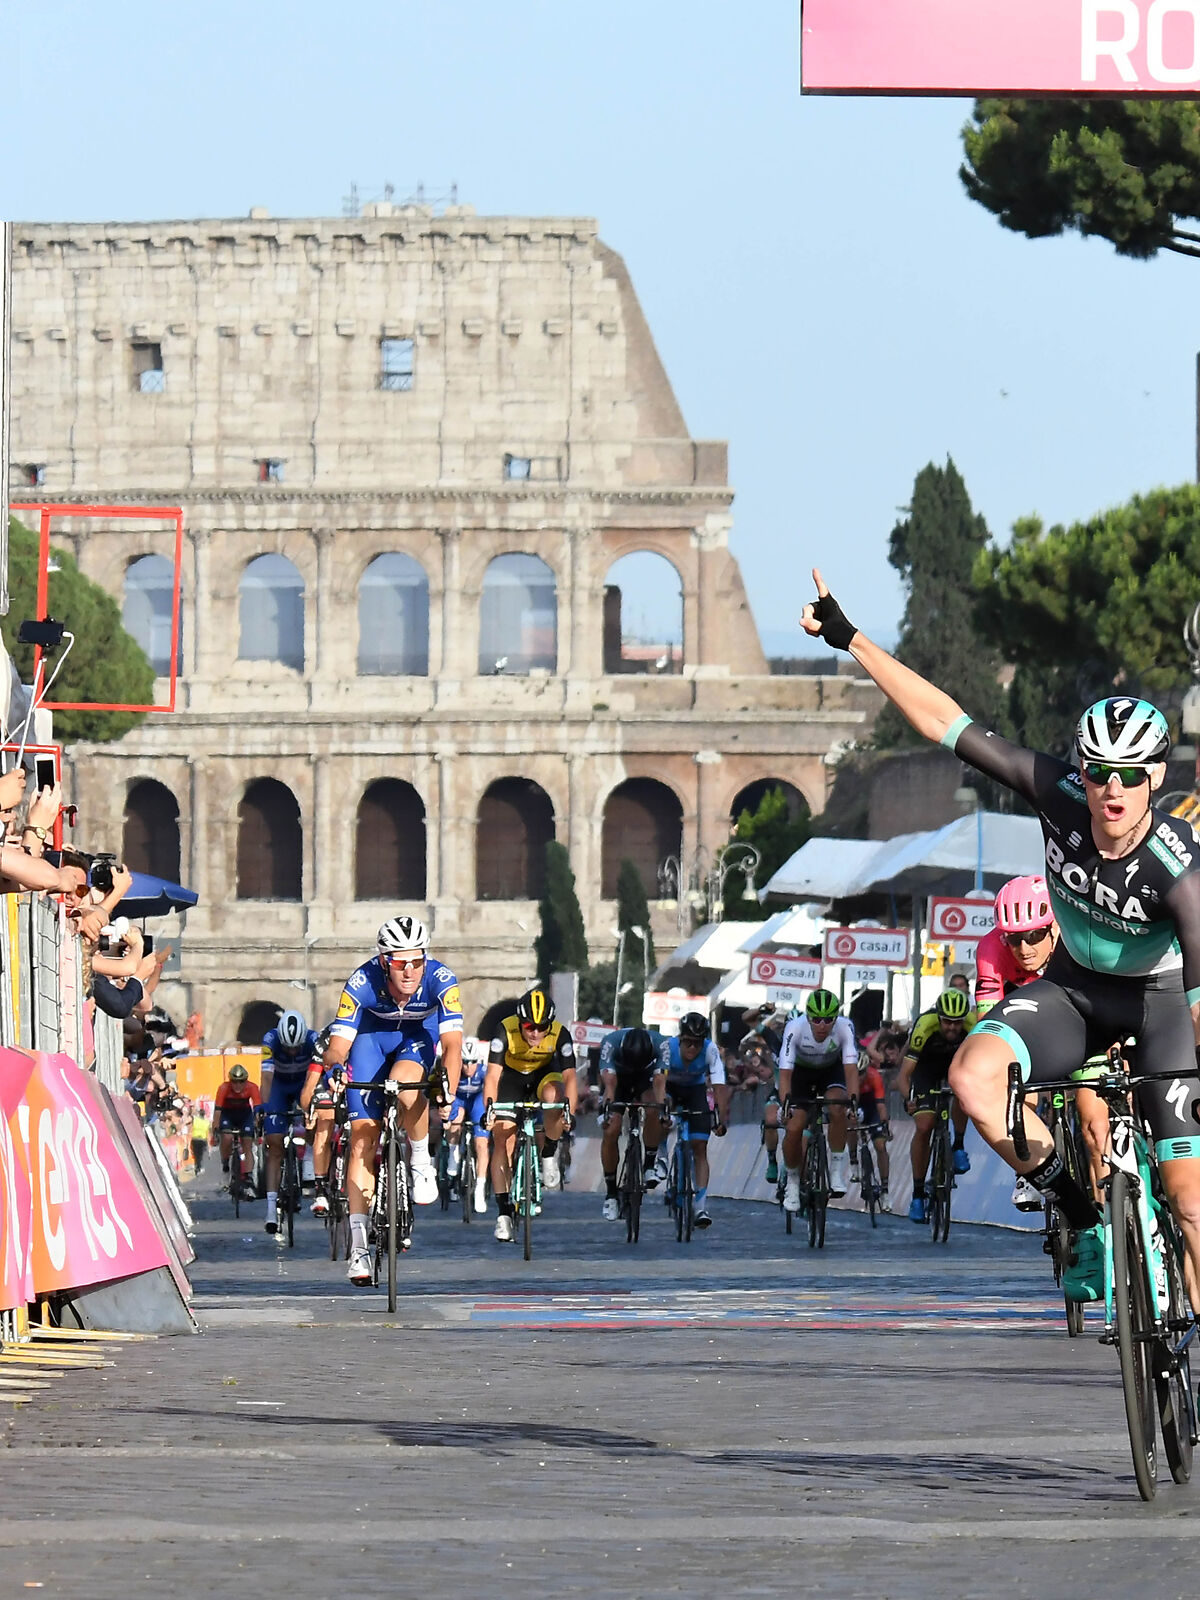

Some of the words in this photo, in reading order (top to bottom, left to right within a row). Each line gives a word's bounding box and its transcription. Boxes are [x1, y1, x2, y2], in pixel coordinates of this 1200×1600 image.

[1156, 822, 1193, 867] BORA
[1046, 837, 1152, 921] BORA
[859, 940, 902, 954] casa.it
[779, 967, 817, 979] casa.it
[856, 970, 876, 981] 125
[775, 991, 793, 1001] 150
[38, 1068, 135, 1272] enel
